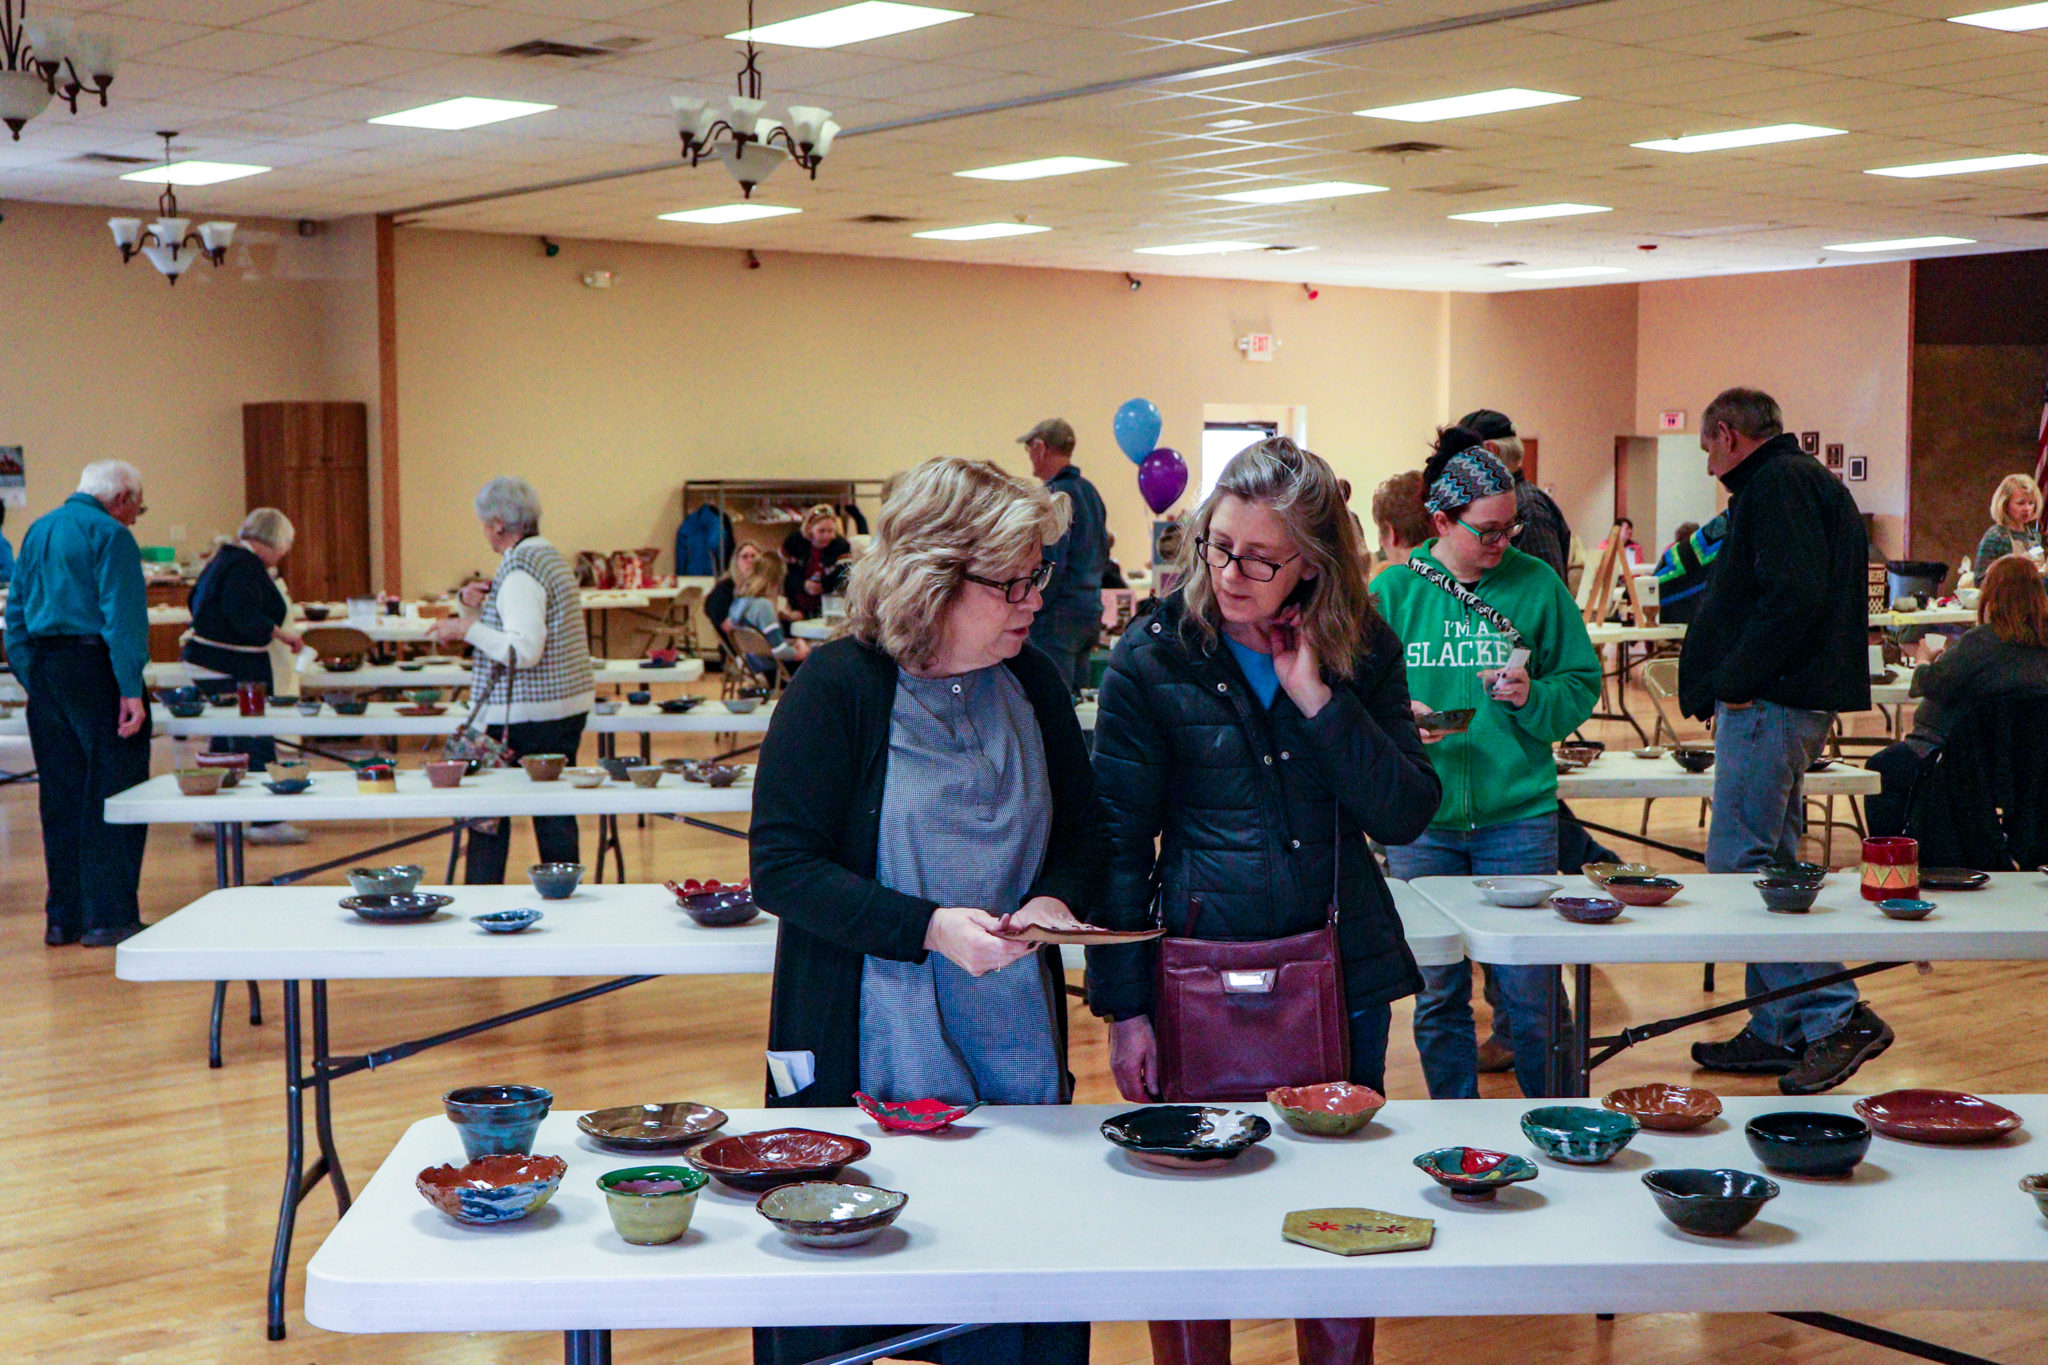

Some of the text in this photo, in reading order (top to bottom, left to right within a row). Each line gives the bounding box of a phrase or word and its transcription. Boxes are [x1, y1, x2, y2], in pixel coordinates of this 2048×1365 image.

[1252, 335, 1269, 352] EXIT
[1443, 620, 1490, 638] I'M A
[1406, 640, 1514, 667] SLACKE
